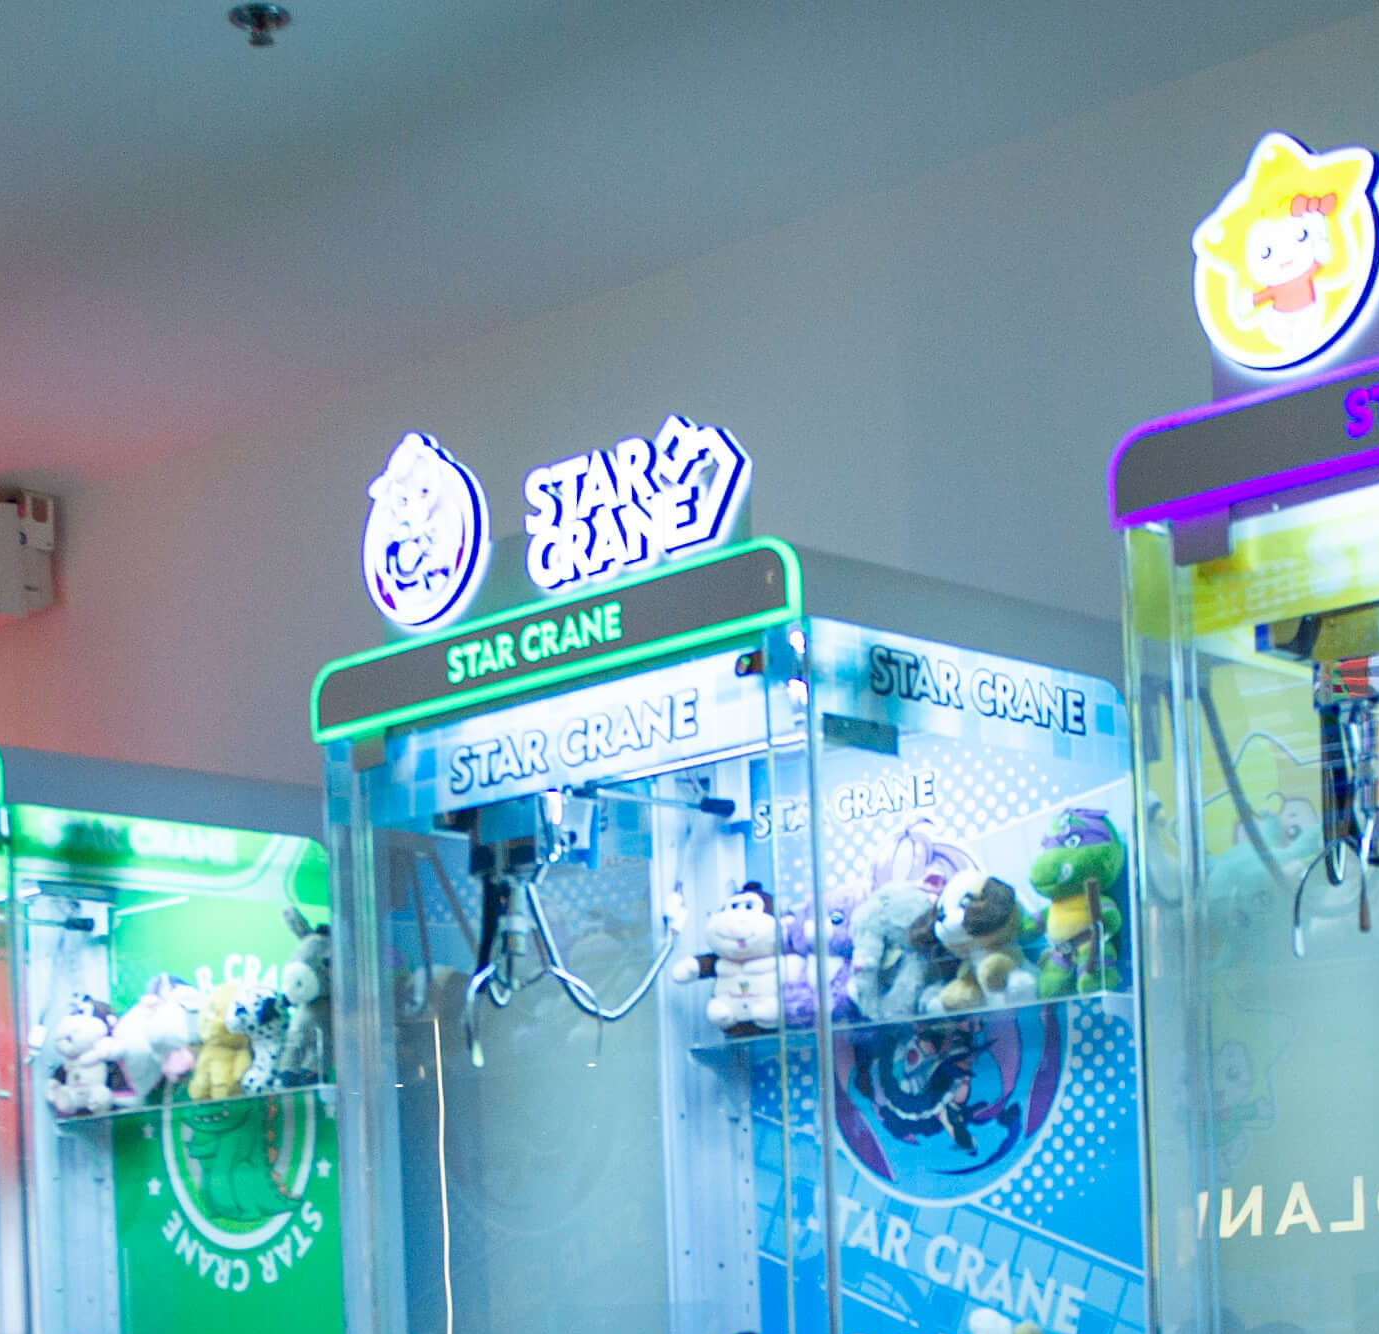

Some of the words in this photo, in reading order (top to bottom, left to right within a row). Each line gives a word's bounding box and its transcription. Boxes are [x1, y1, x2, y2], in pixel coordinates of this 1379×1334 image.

[524, 436, 660, 535] STAR
[526, 486, 700, 588] CRANE
[447, 633, 517, 684] STAR
[520, 601, 623, 662] CRANE
[869, 645, 964, 709] STAR
[971, 668, 1086, 736] CRANE
[450, 730, 549, 795] STAR
[559, 688, 698, 767] CRANE
[753, 797, 817, 839] STA
[834, 771, 936, 822] CRANE
[223, 952, 279, 990] CRA
[162, 1210, 250, 1292] CRANE
[257, 1201, 323, 1284] STAR
[835, 1195, 911, 1269] TAR
